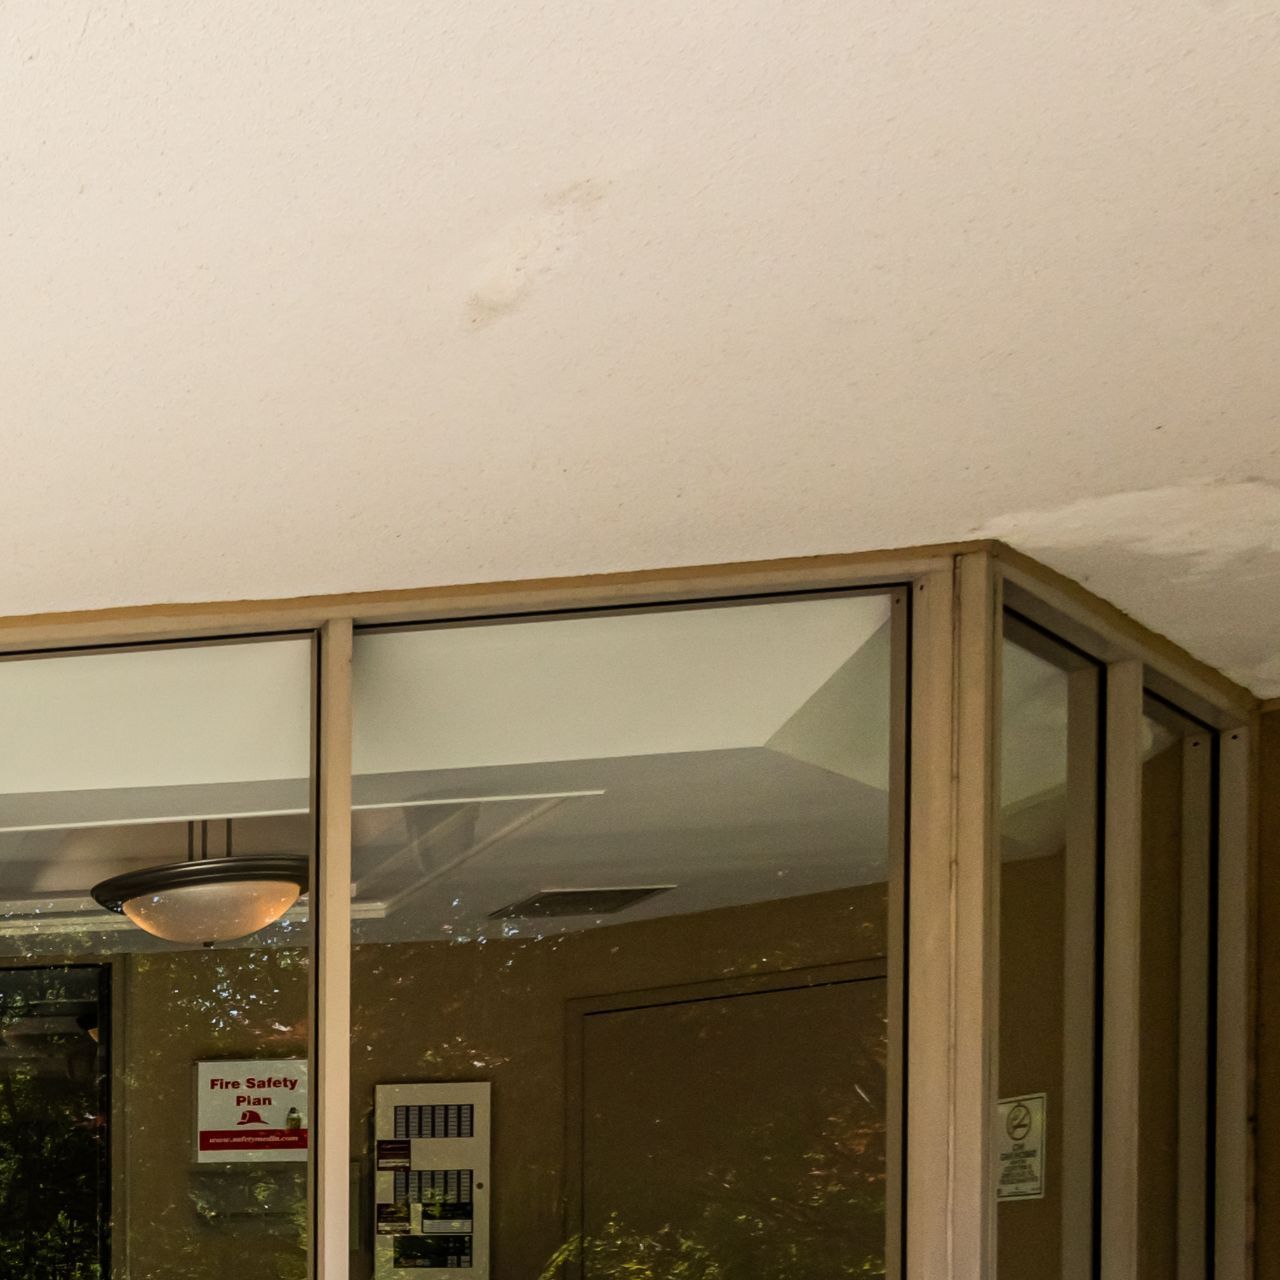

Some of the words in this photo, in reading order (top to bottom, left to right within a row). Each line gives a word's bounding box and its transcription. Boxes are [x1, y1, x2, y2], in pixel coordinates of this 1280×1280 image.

[210, 1078, 241, 1090] Fire
[246, 1077, 299, 1091] Safety
[236, 1095, 273, 1107] Plan
